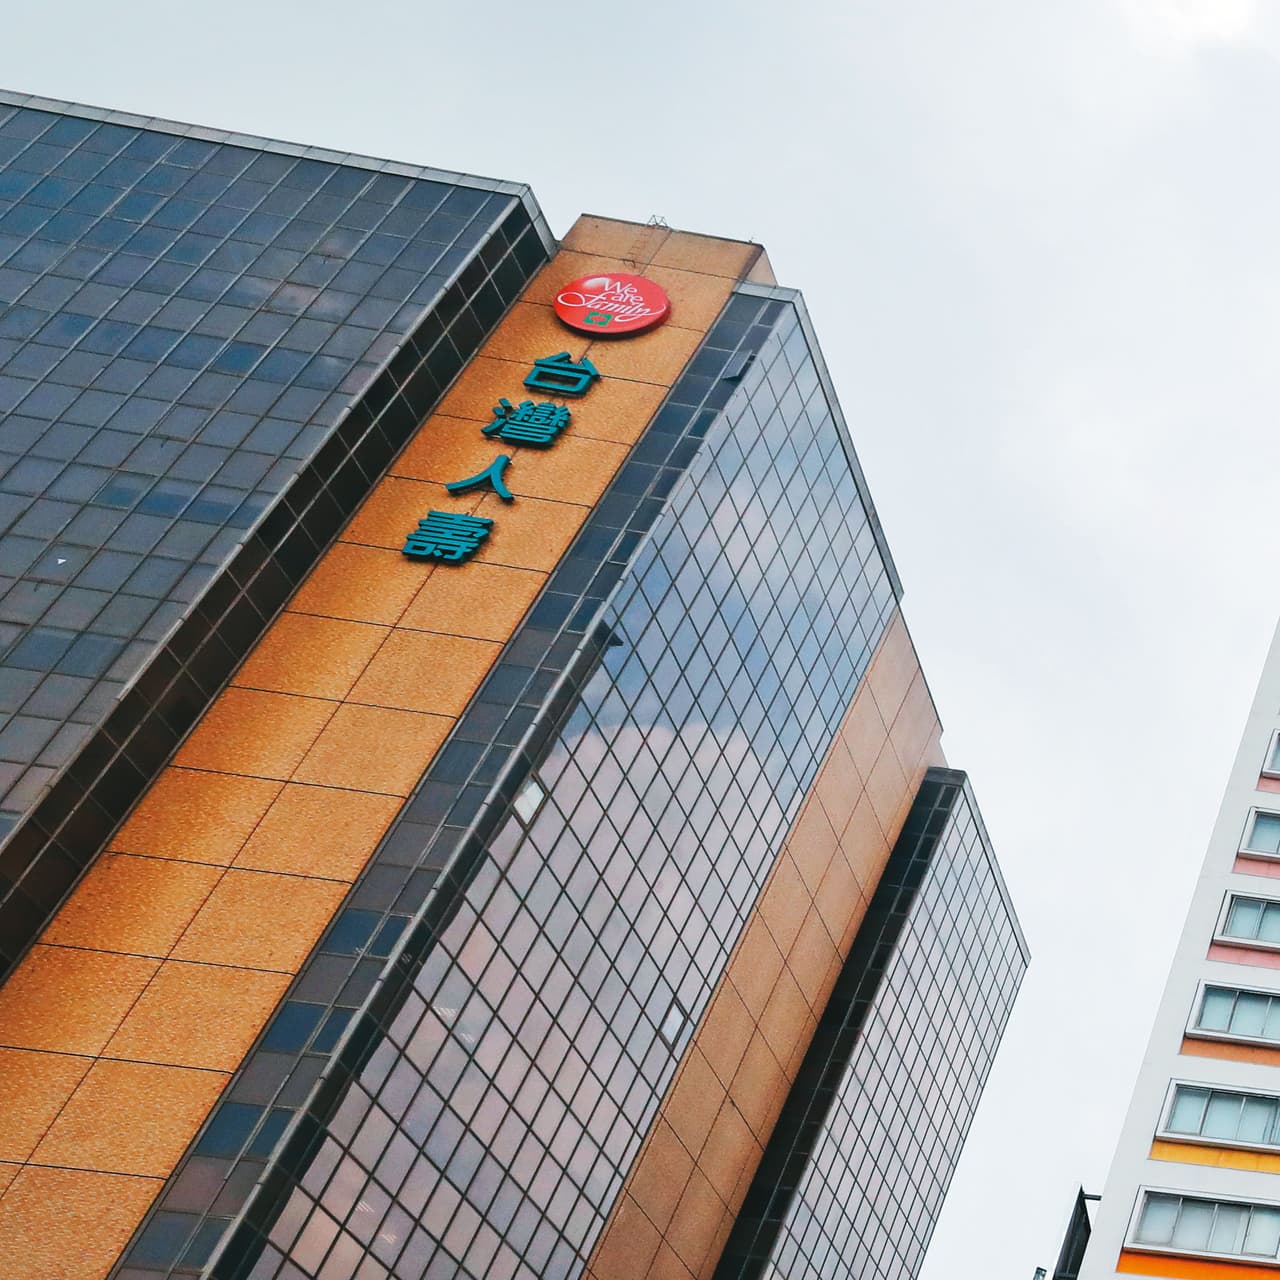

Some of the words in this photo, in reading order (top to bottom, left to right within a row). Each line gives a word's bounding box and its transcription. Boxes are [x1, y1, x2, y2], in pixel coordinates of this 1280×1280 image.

[603, 279, 638, 294] We
[401, 351, 600, 566] 台灣人壽
